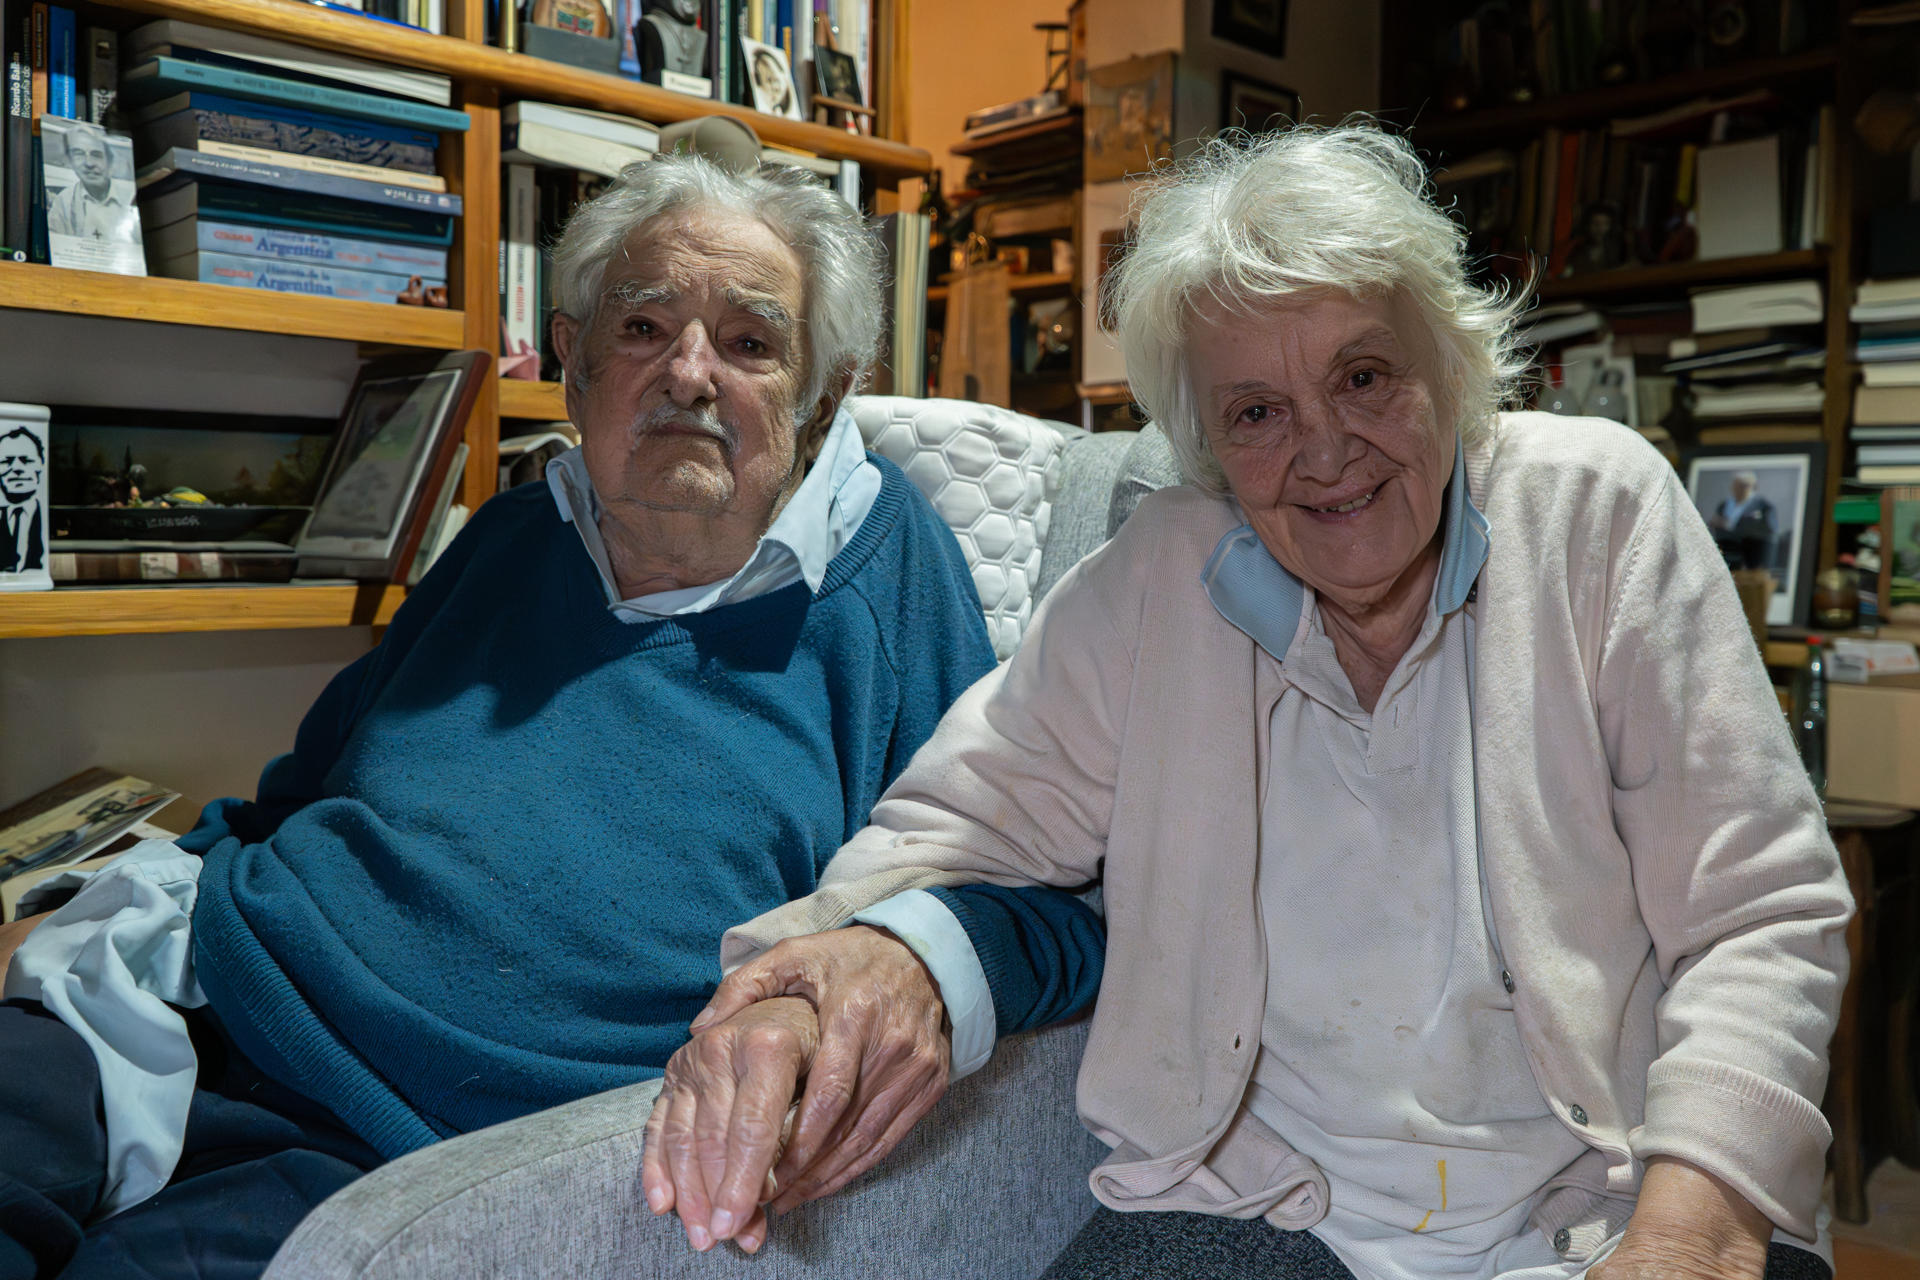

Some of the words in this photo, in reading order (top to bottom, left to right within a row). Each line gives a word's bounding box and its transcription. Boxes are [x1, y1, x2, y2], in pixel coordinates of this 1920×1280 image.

[10, 82, 20, 117] Ricardo
[256, 237, 333, 259] Argentina
[256, 272, 333, 295] Argentina
